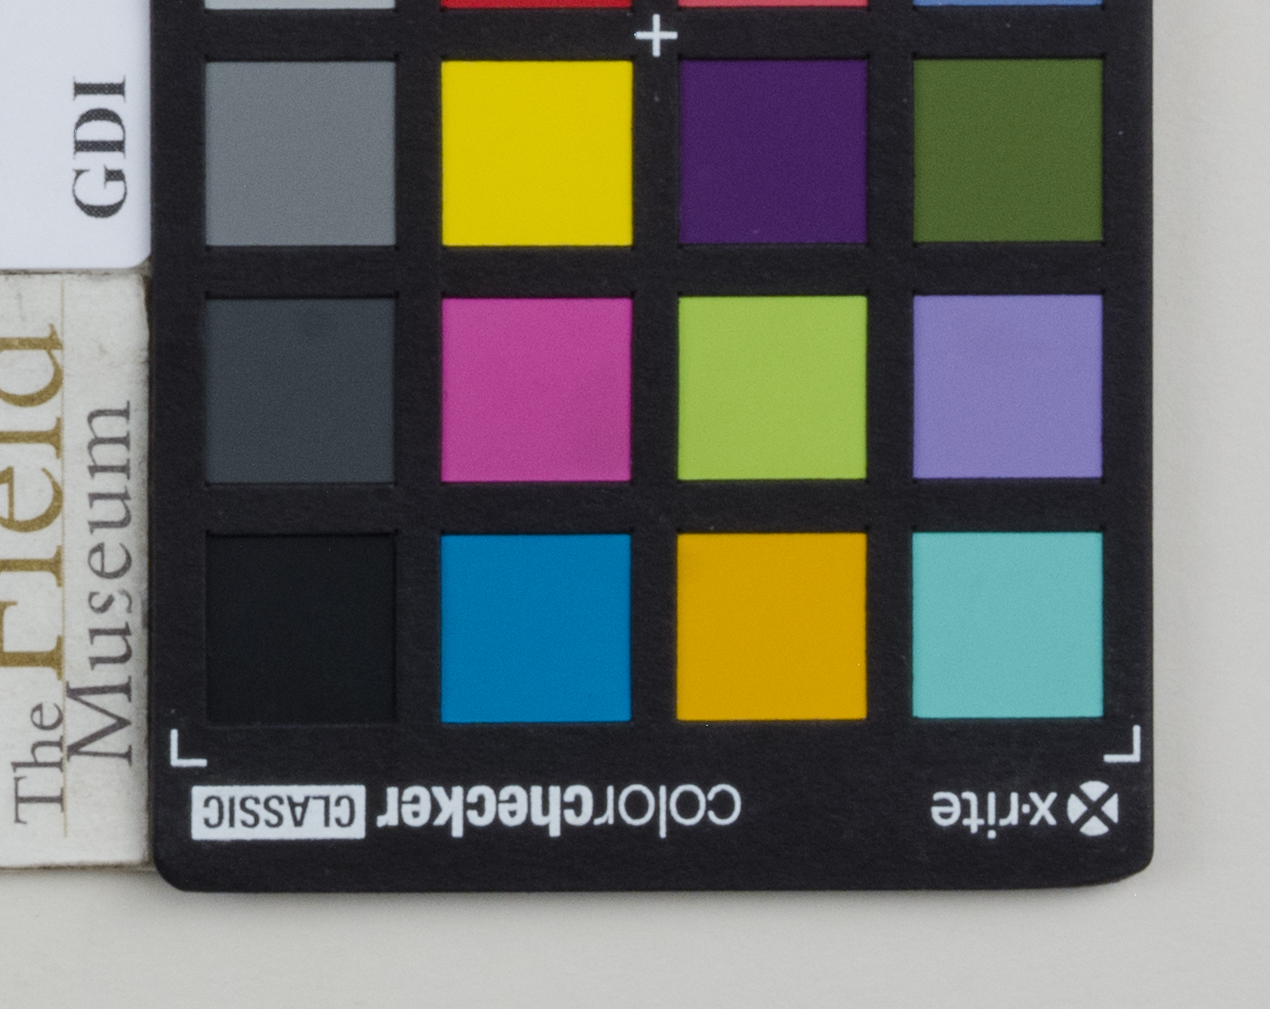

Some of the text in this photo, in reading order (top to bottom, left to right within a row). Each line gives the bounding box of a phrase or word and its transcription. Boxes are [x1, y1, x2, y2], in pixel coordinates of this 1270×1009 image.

[72, 75, 127, 219] GDI
[66, 400, 133, 767] Museum
[10, 701, 64, 825] The
[202, 783, 742, 839] colorchecker CLASSIC
